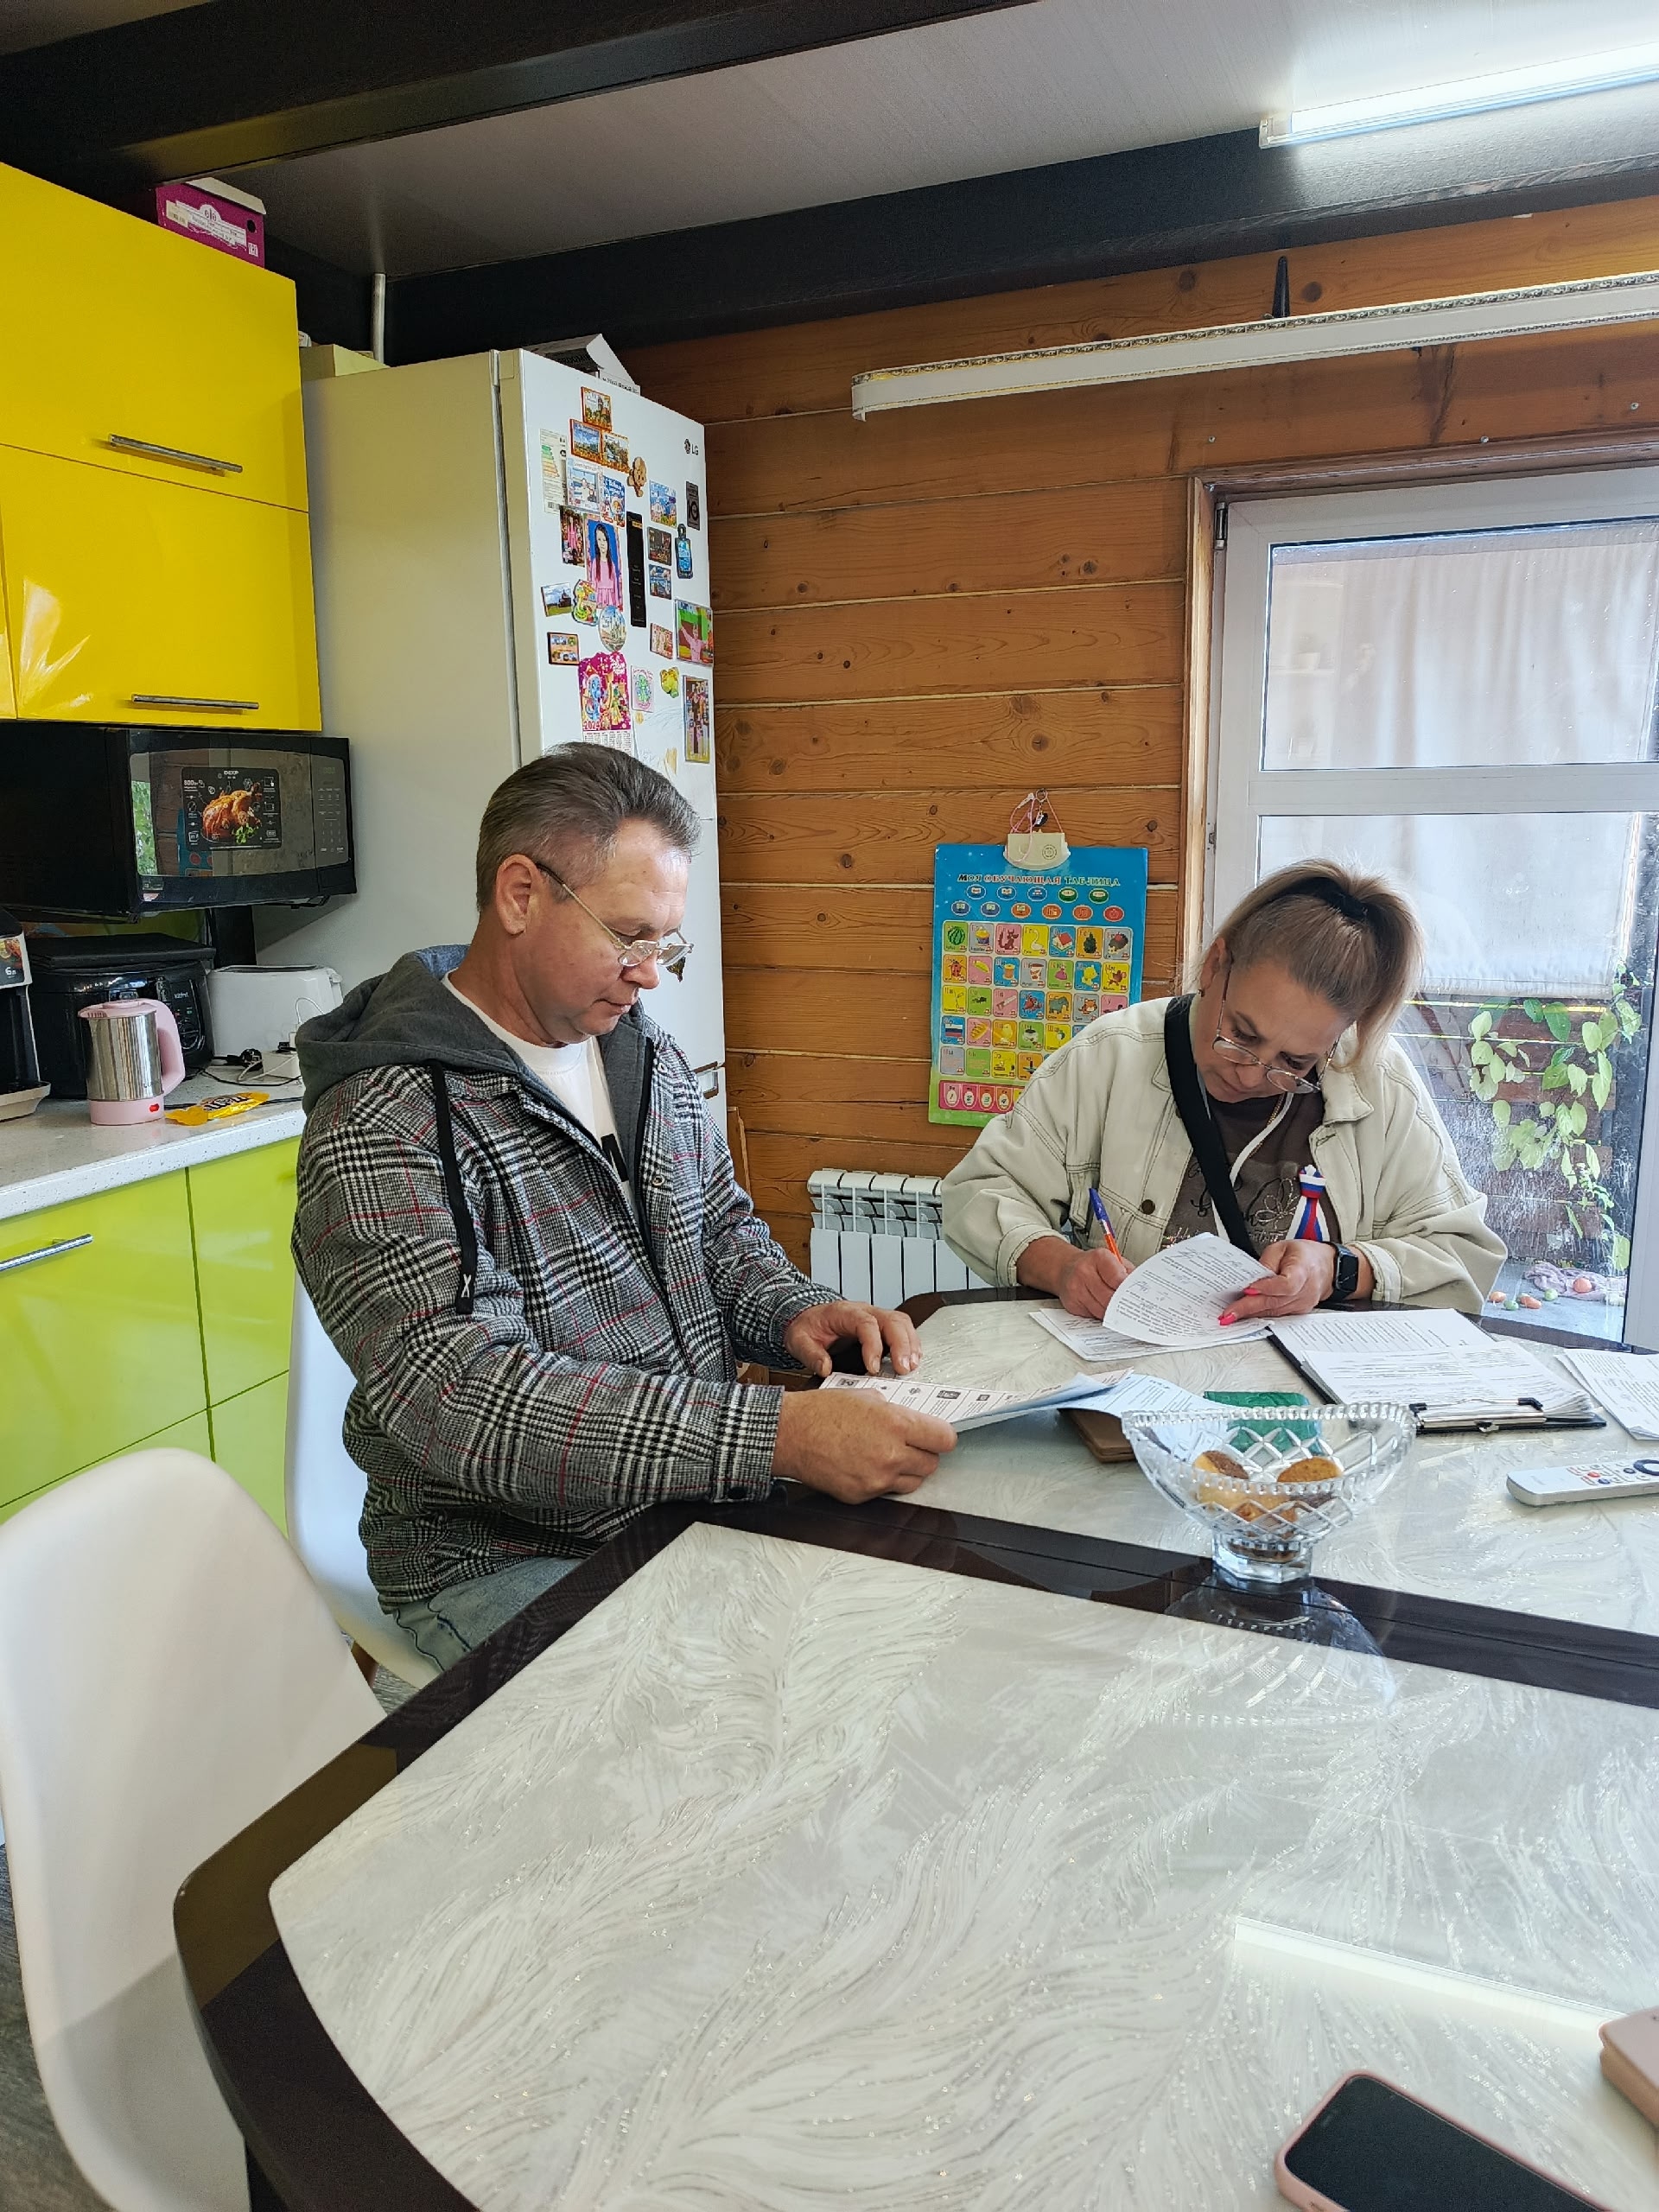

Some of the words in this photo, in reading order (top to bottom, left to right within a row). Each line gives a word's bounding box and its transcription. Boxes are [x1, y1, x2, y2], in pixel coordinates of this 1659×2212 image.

[691, 443, 699, 455] LG
[583, 720, 600, 730] 2024
[983, 874, 1062, 886] ОБУЧАЮЩАЯ
[1064, 875, 1121, 887] ТАБЛИЦА
